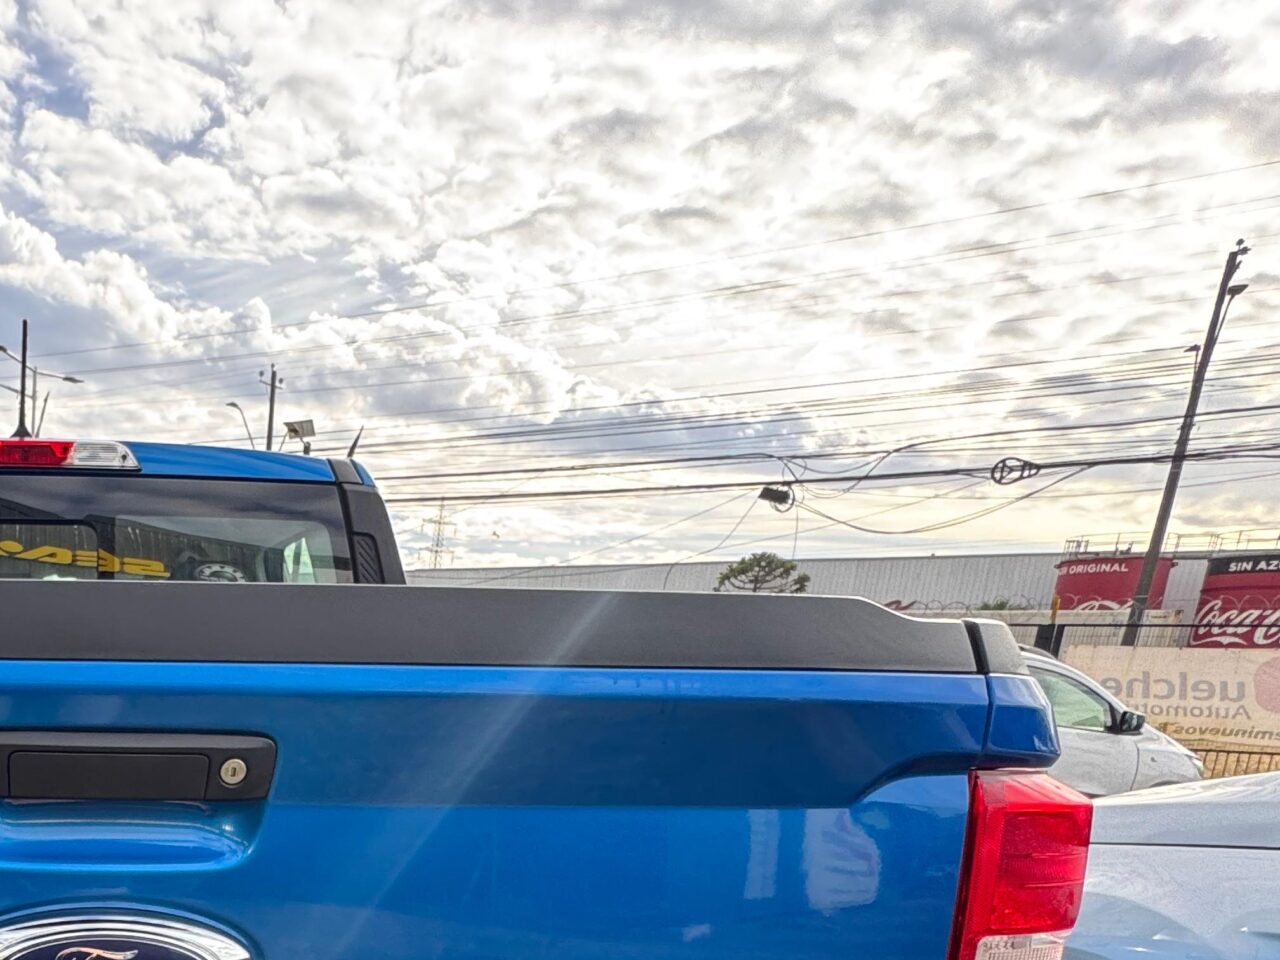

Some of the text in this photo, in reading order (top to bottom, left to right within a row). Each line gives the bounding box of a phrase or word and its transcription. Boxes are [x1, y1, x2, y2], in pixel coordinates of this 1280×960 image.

[1069, 562, 1129, 575] ORIGINAL
[1228, 560, 1280, 572] SIN AZ
